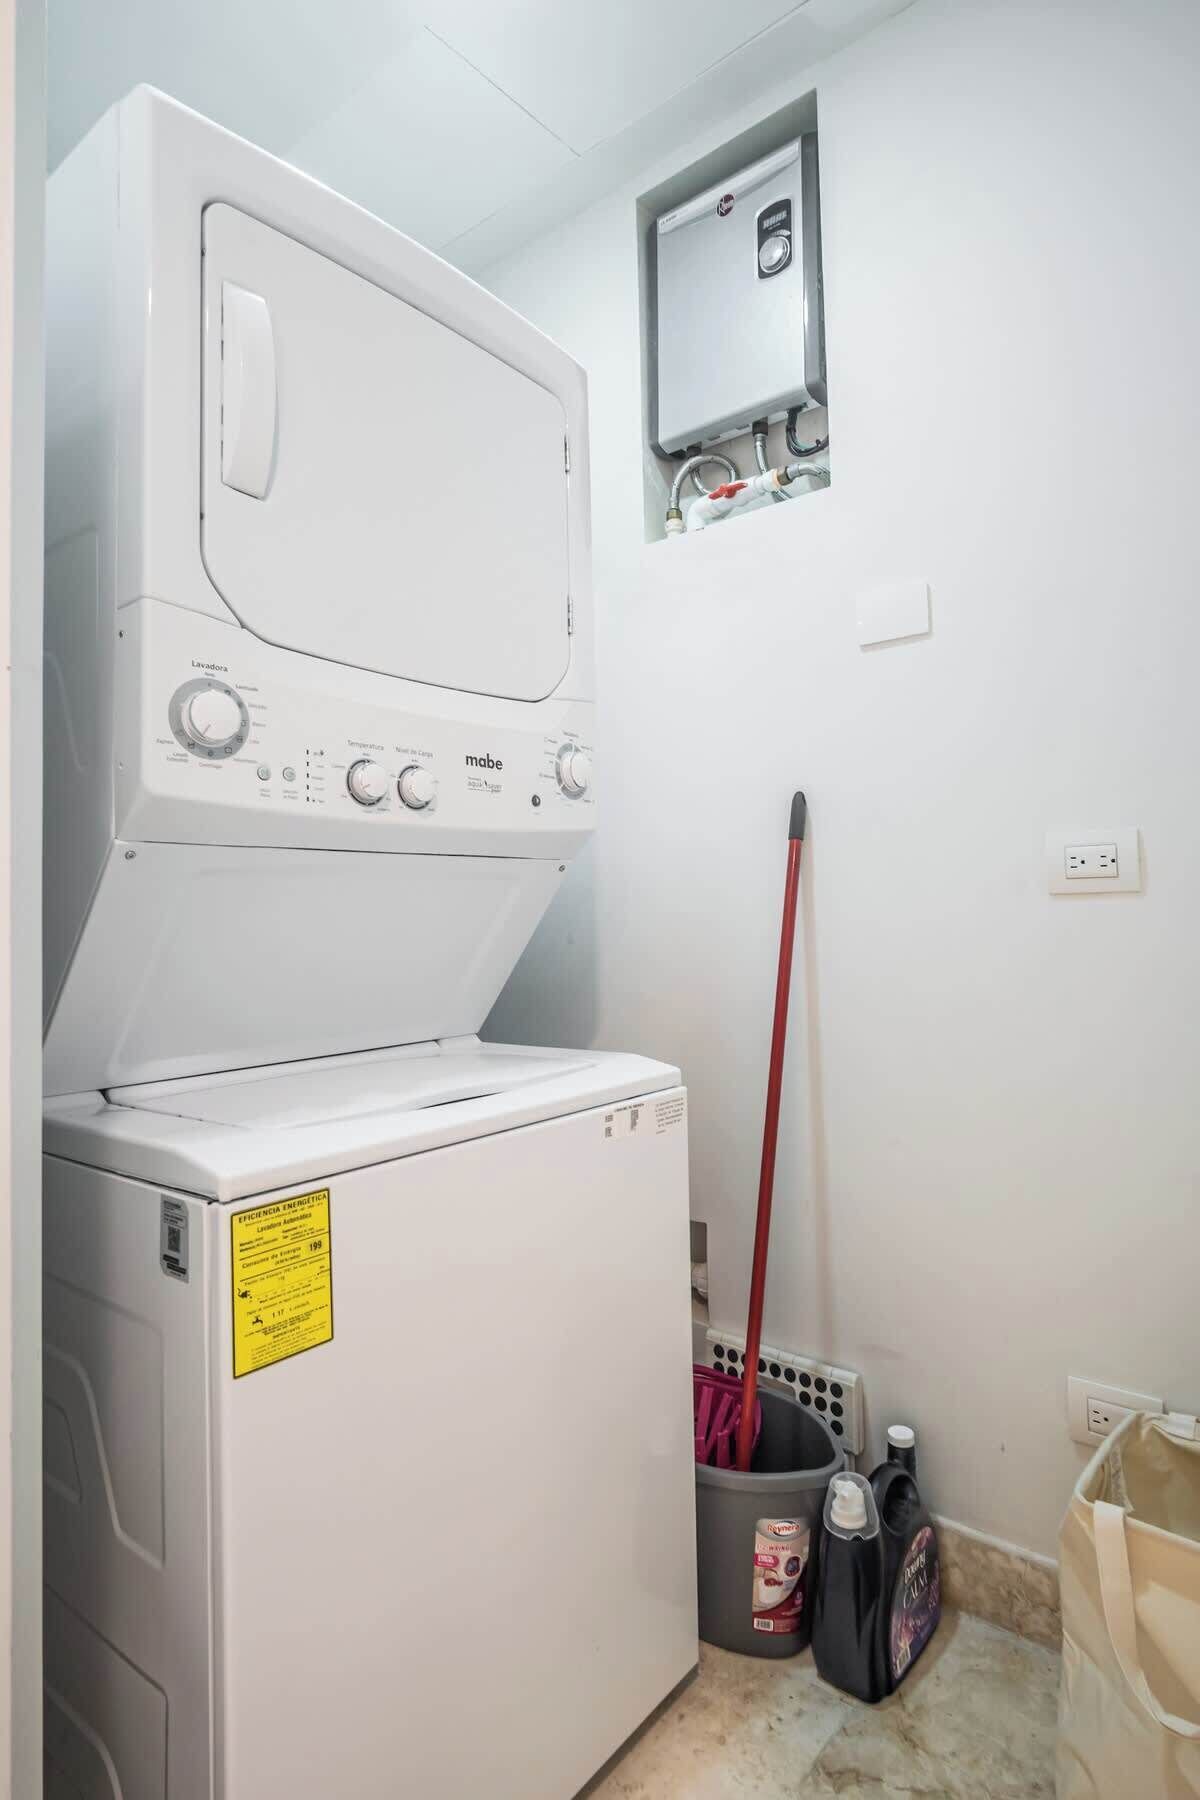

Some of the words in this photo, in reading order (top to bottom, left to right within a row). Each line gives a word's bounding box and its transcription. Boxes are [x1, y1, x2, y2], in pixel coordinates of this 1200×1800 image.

[191, 659, 229, 673] Lavadora
[465, 752, 503, 771] mabe
[238, 1207, 281, 1223] EFICIENCIA
